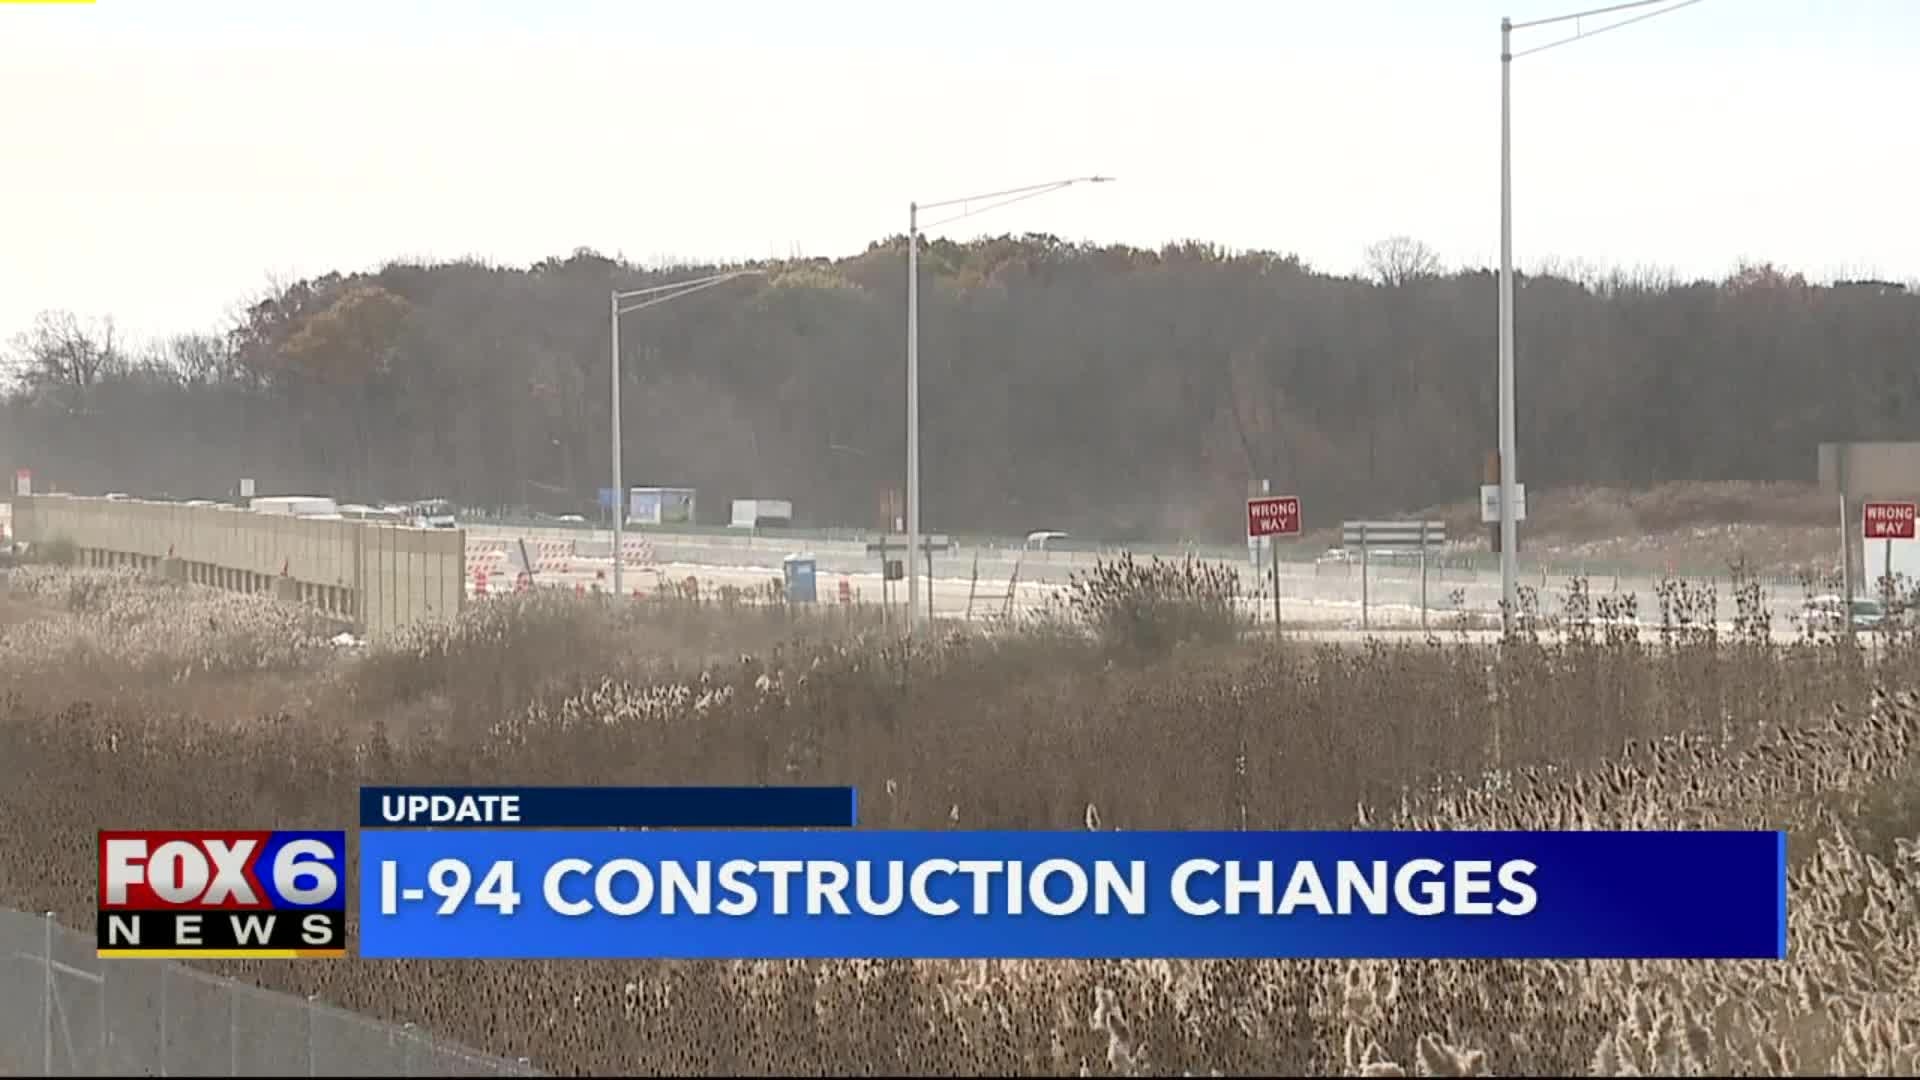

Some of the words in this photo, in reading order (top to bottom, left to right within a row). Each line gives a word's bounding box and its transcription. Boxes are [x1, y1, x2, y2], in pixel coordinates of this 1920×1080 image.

[1250, 502, 1296, 517] WRONG
[1867, 506, 1913, 520] WRONG
[1260, 517, 1287, 531] WAY
[1875, 521, 1904, 535] WAY
